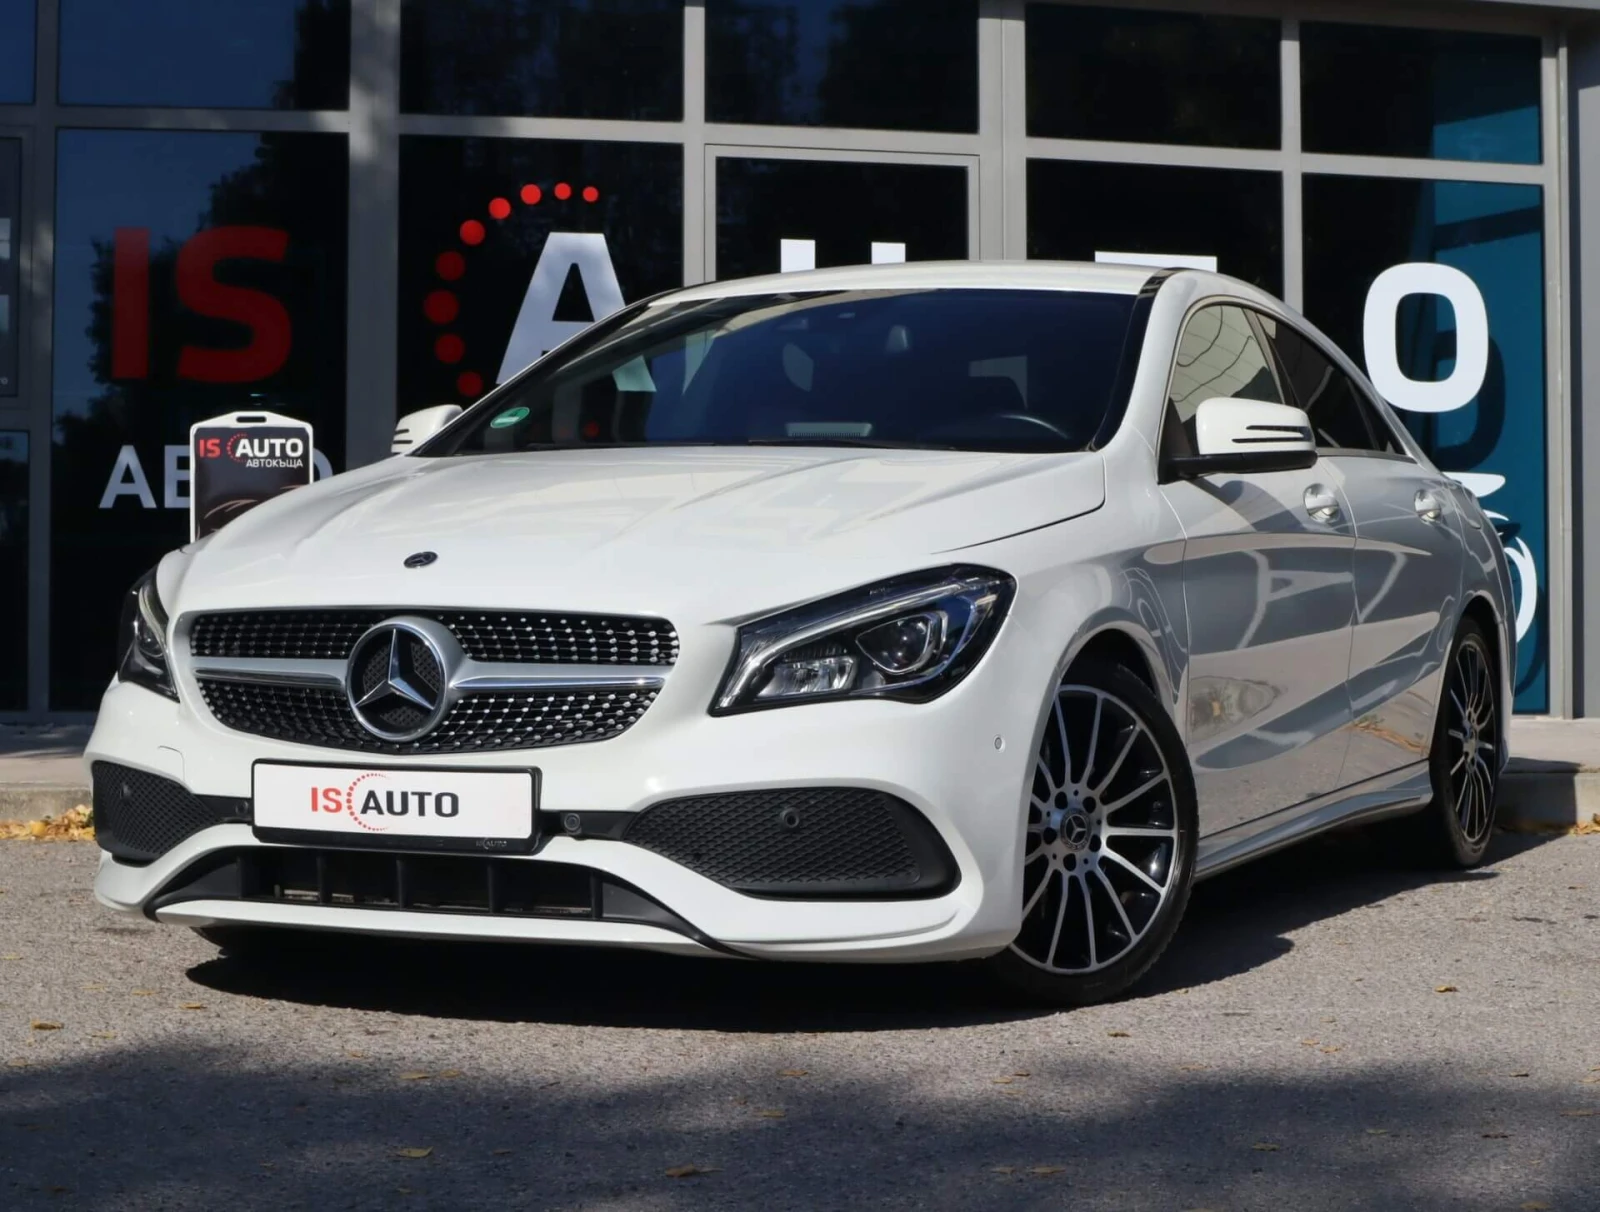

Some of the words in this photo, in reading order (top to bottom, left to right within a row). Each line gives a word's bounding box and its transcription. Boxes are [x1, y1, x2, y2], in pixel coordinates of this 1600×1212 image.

[111, 225, 292, 383] IS
[199, 438, 221, 458] IS
[235, 438, 304, 458] AUTO
[311, 787, 342, 813] IS
[360, 790, 460, 818] AUTO
